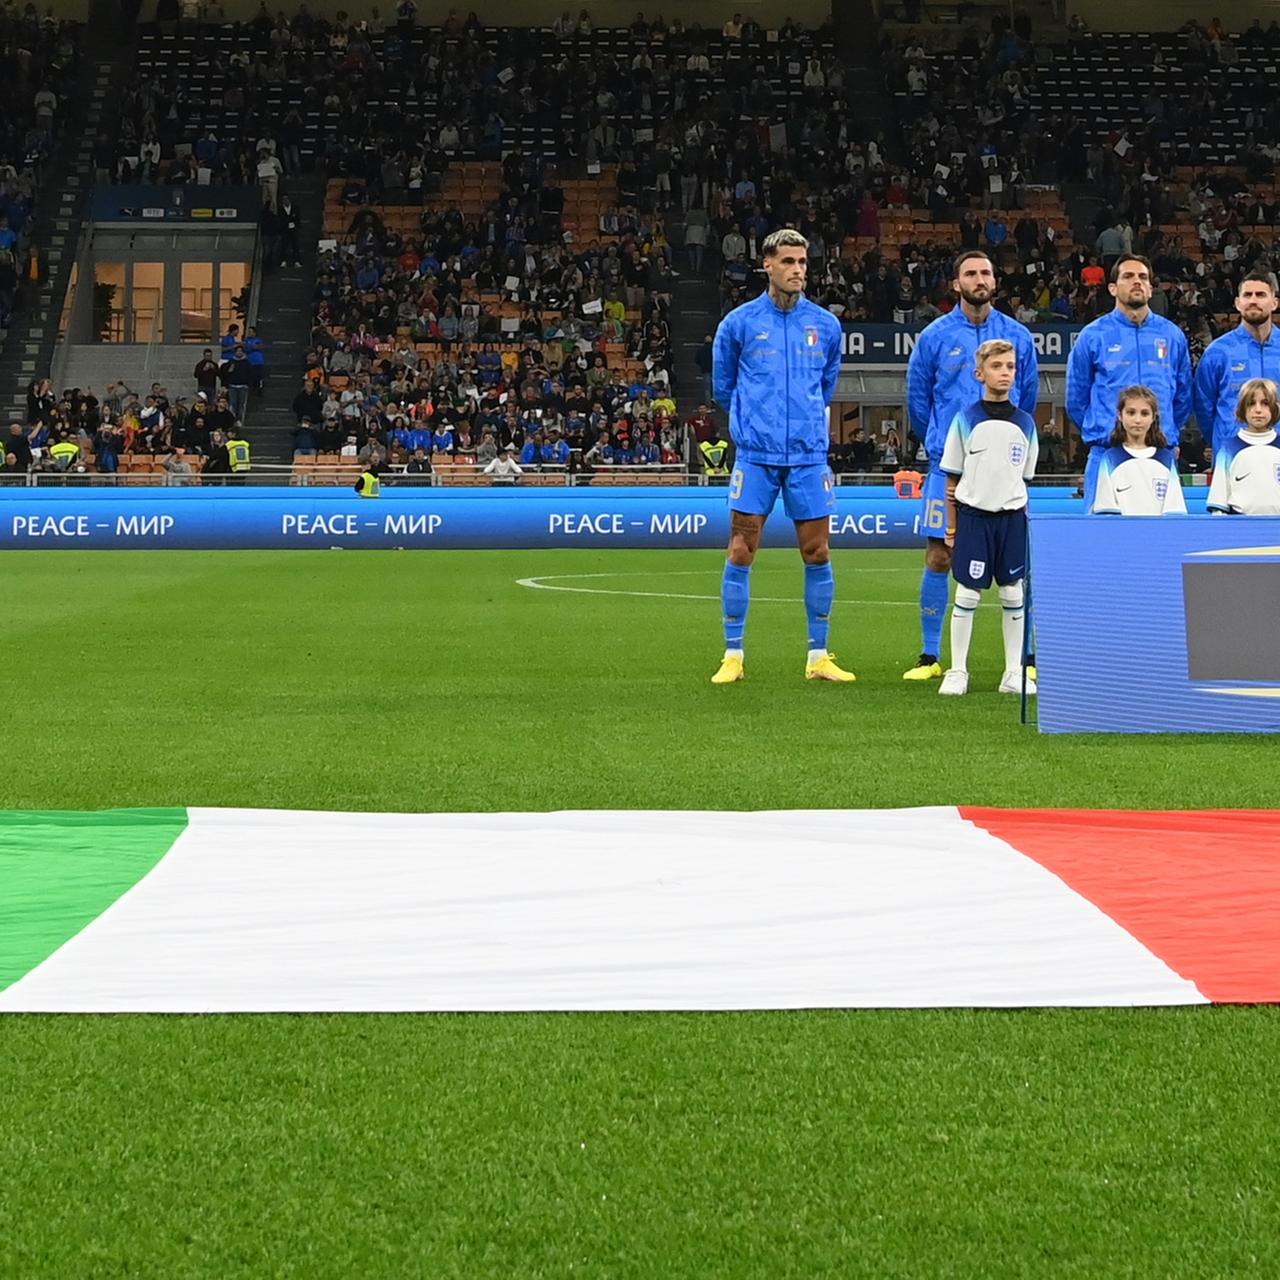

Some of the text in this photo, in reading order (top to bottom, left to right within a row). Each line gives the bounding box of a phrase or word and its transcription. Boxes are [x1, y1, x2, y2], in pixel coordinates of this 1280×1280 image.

[13, 515, 90, 536] PEACE
[116, 515, 175, 535] МИР
[282, 514, 358, 535] PEACE
[384, 514, 443, 534] МИР
[549, 514, 625, 535] PEACE
[650, 514, 708, 534] МИР
[828, 514, 888, 535] EACE
